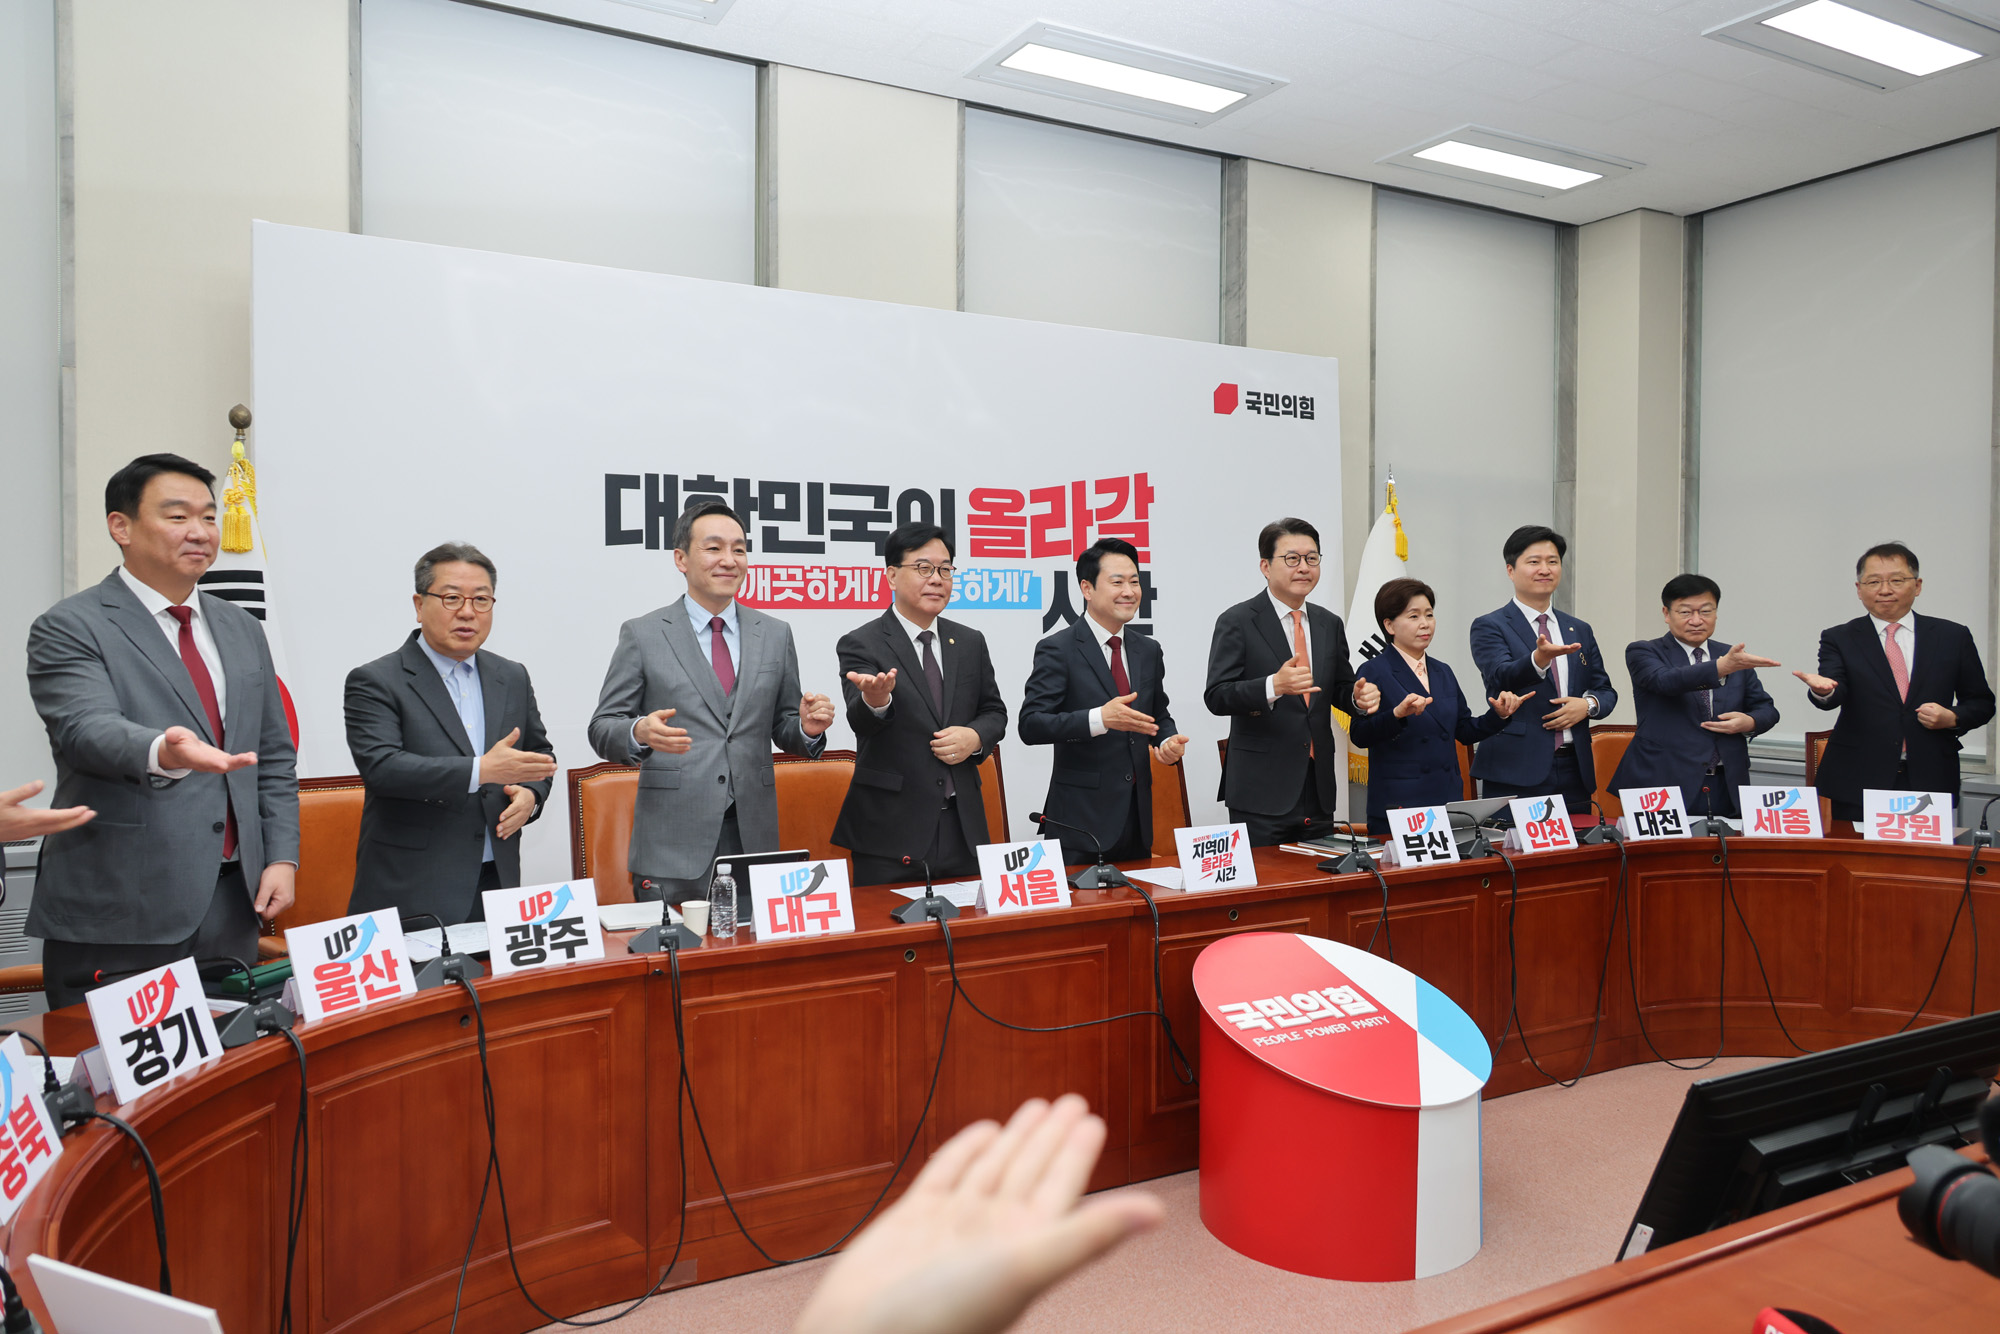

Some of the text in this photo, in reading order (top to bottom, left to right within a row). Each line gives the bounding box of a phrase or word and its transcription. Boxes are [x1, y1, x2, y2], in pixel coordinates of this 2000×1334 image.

[1245, 391, 1315, 421] 국민의힘
[967, 472, 1155, 563] 올라갈
[738, 567, 882, 603] 깨끗하게!
[1528, 800, 1546, 822] UP
[1639, 791, 1659, 811] UP
[1762, 790, 1786, 808] UP
[1889, 795, 1916, 813] UP
[1407, 812, 1427, 833] UP
[1525, 818, 1571, 850] 인천
[1634, 808, 1684, 837] 대전
[1754, 808, 1811, 835] 세종
[1876, 813, 1941, 842] 강원
[1004, 847, 1030, 872] UP
[1192, 836, 1230, 860] 지역이
[1403, 830, 1452, 863] 부산
[1201, 852, 1234, 873] 올라갈
[1215, 866, 1237, 884] 시간
[780, 867, 811, 895] UP
[998, 869, 1060, 908] 서울
[519, 890, 554, 923] UP
[767, 892, 841, 934] 대구
[324, 923, 359, 961] UP
[505, 916, 589, 967] 광주
[313, 948, 402, 1014] 울산
[127, 979, 160, 1025] UP
[1218, 985, 1379, 1031] 국민의힘
[120, 1005, 209, 1087] 경기
[1252, 1015, 1390, 1048] PEOPLE POWER PARTY
